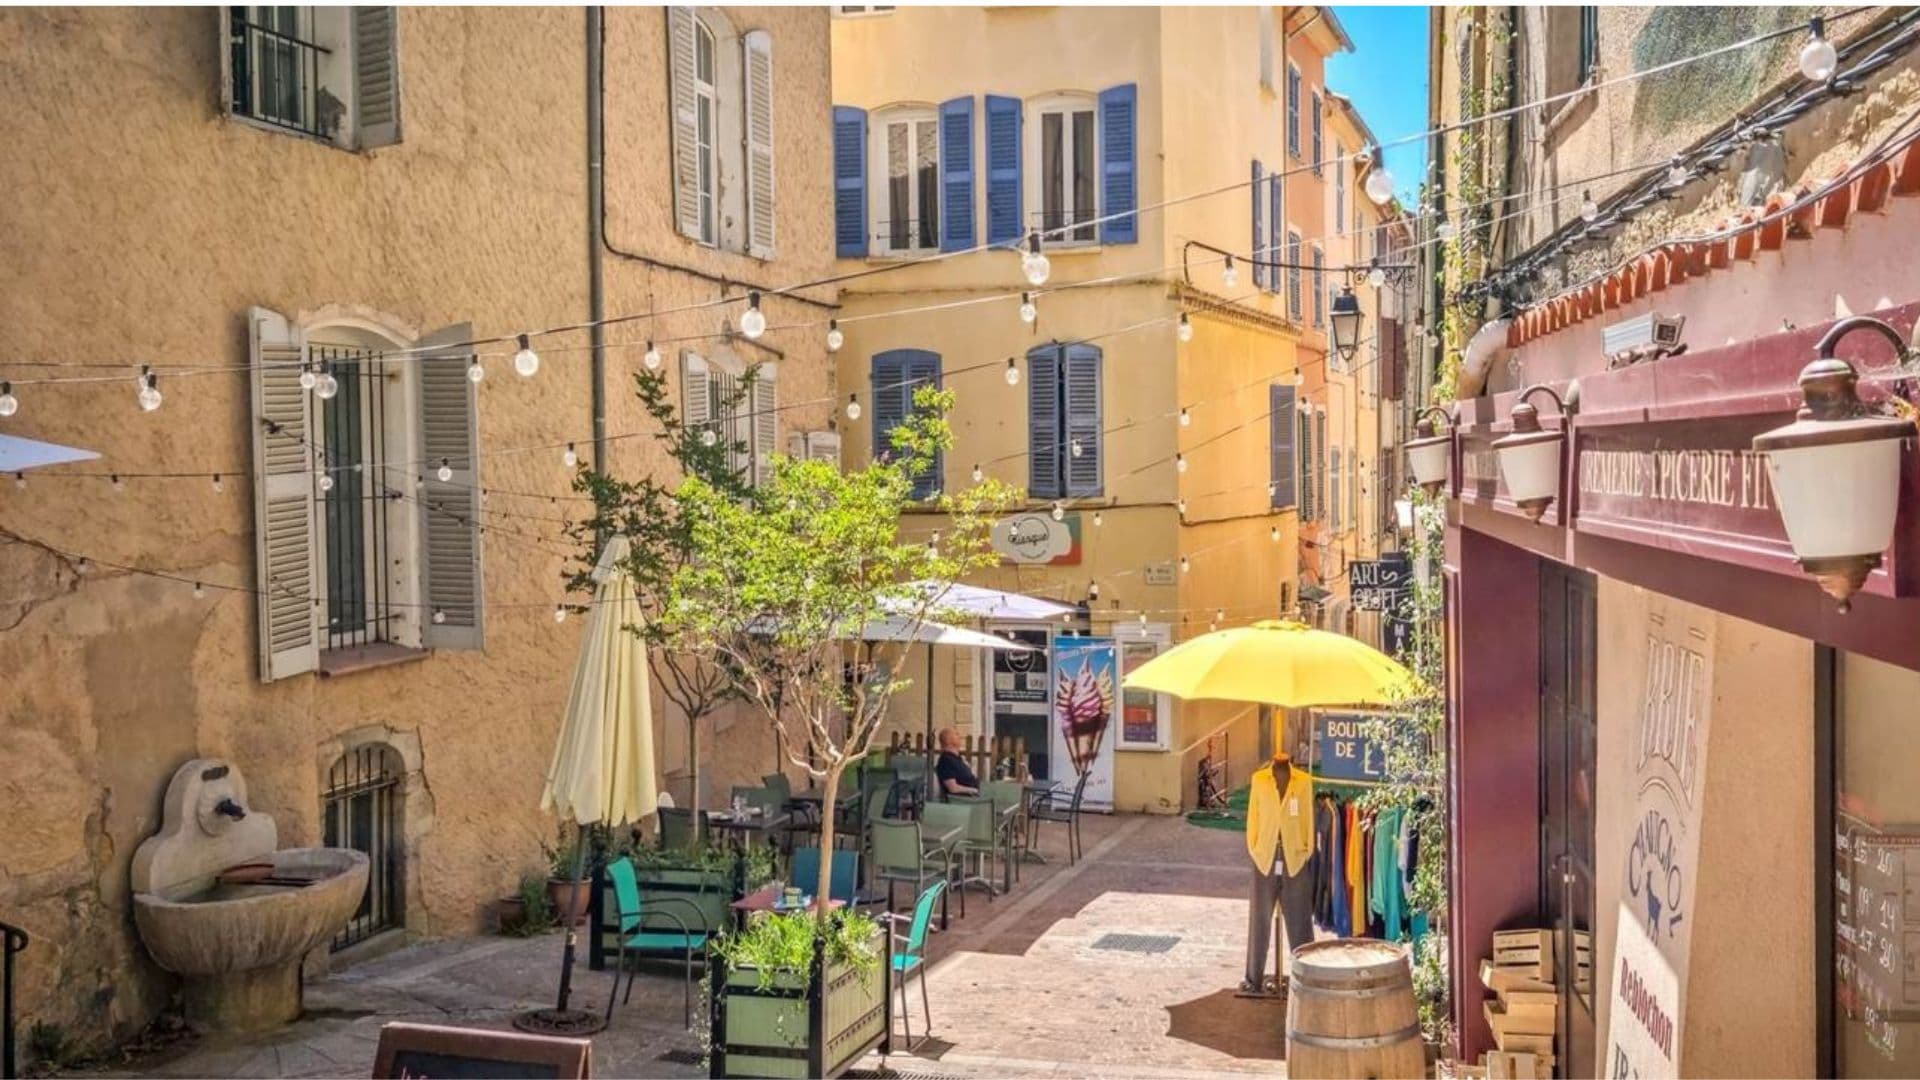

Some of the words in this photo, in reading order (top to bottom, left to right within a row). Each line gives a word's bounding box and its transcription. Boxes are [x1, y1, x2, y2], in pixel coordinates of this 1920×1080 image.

[1740, 449, 1769, 509] FIN
[1336, 741, 1356, 758] DE
[1620, 956, 1673, 1062] Reblochon
